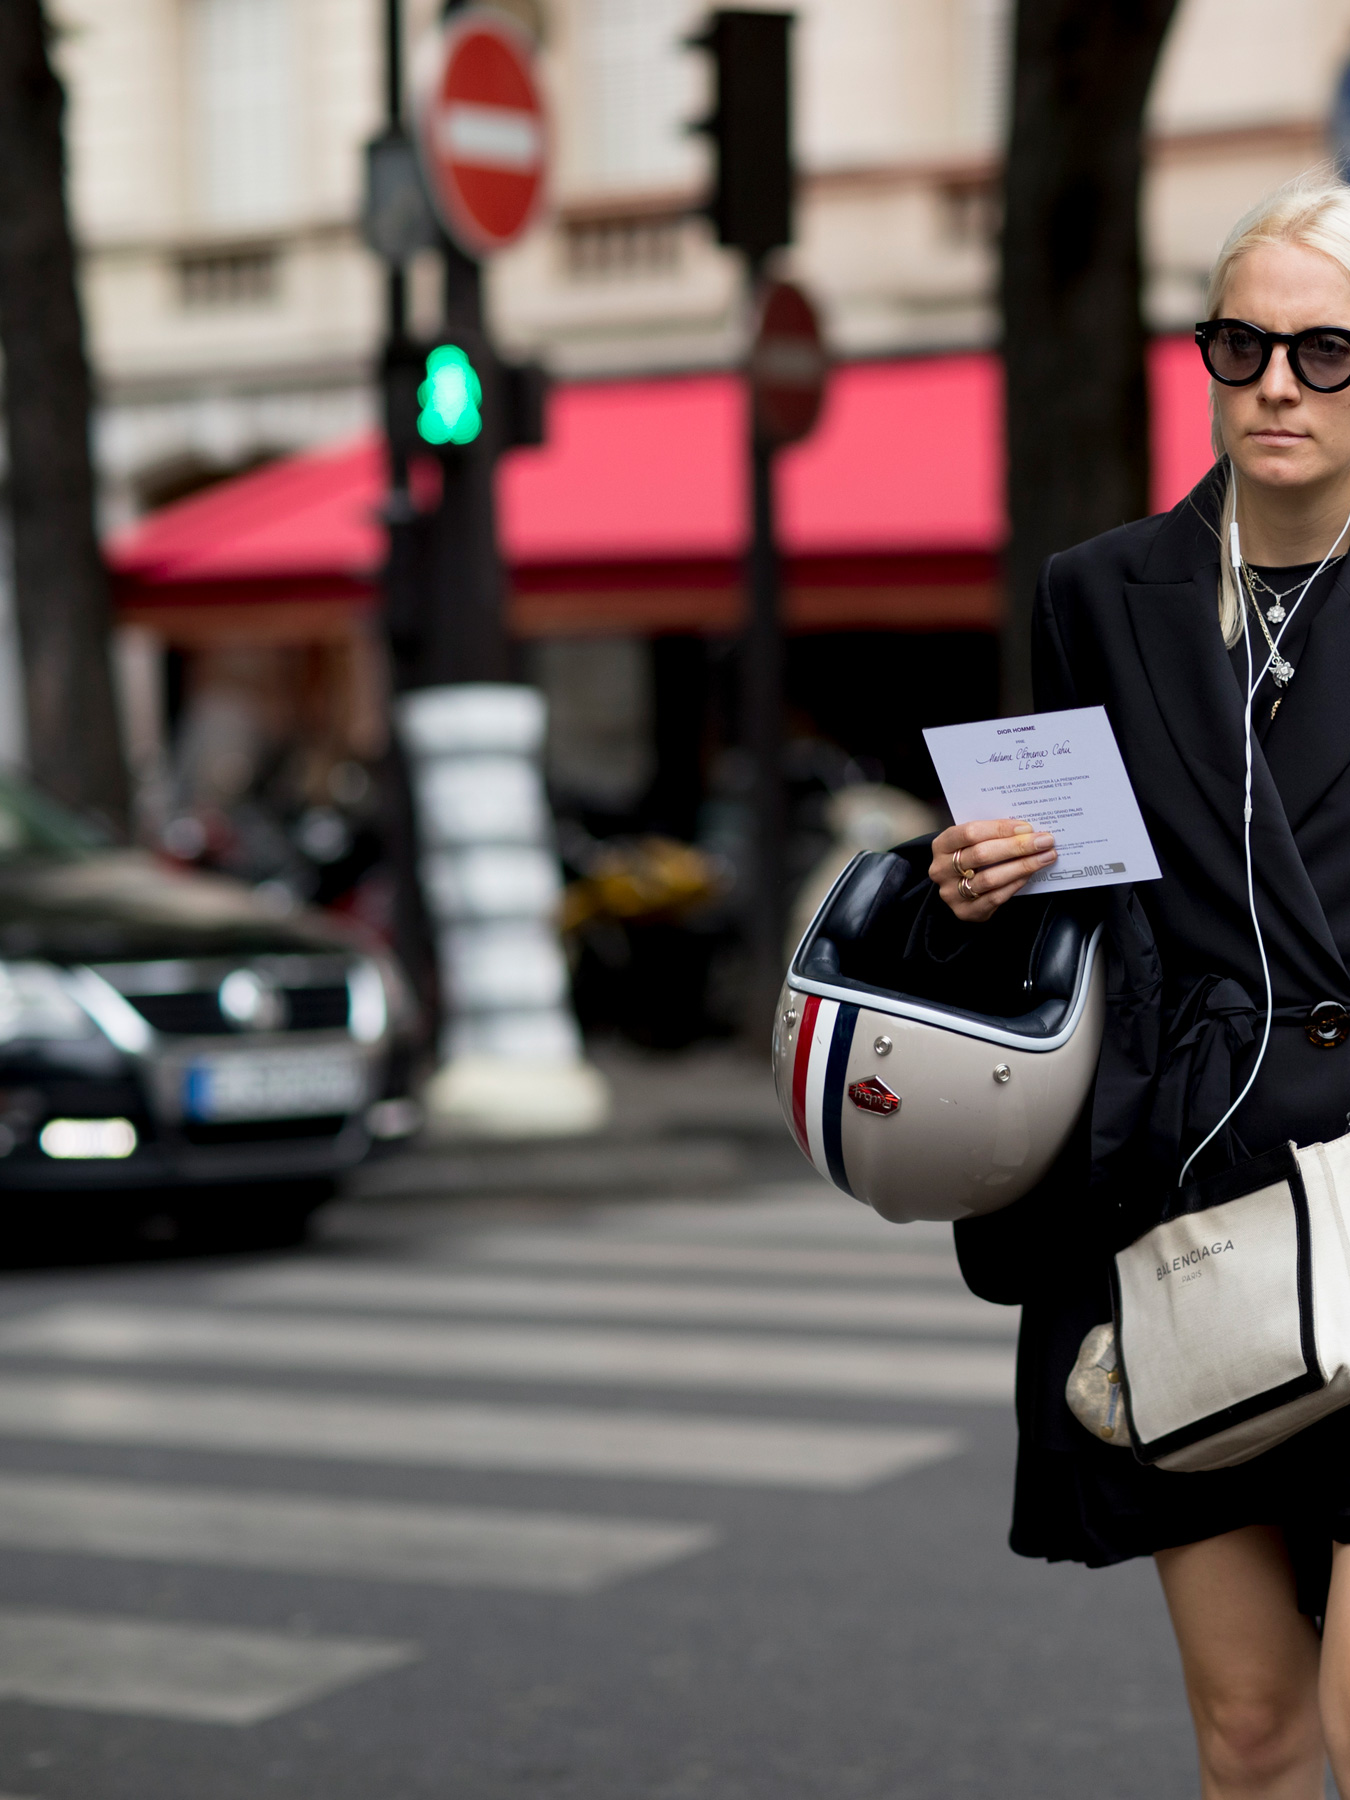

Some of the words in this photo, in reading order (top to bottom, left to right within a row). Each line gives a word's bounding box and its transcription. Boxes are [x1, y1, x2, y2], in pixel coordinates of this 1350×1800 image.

[852, 1083, 891, 1109] Ruby
[1156, 1239, 1234, 1281] BALENCIAGA
[1182, 1269, 1202, 1283] PARIS
